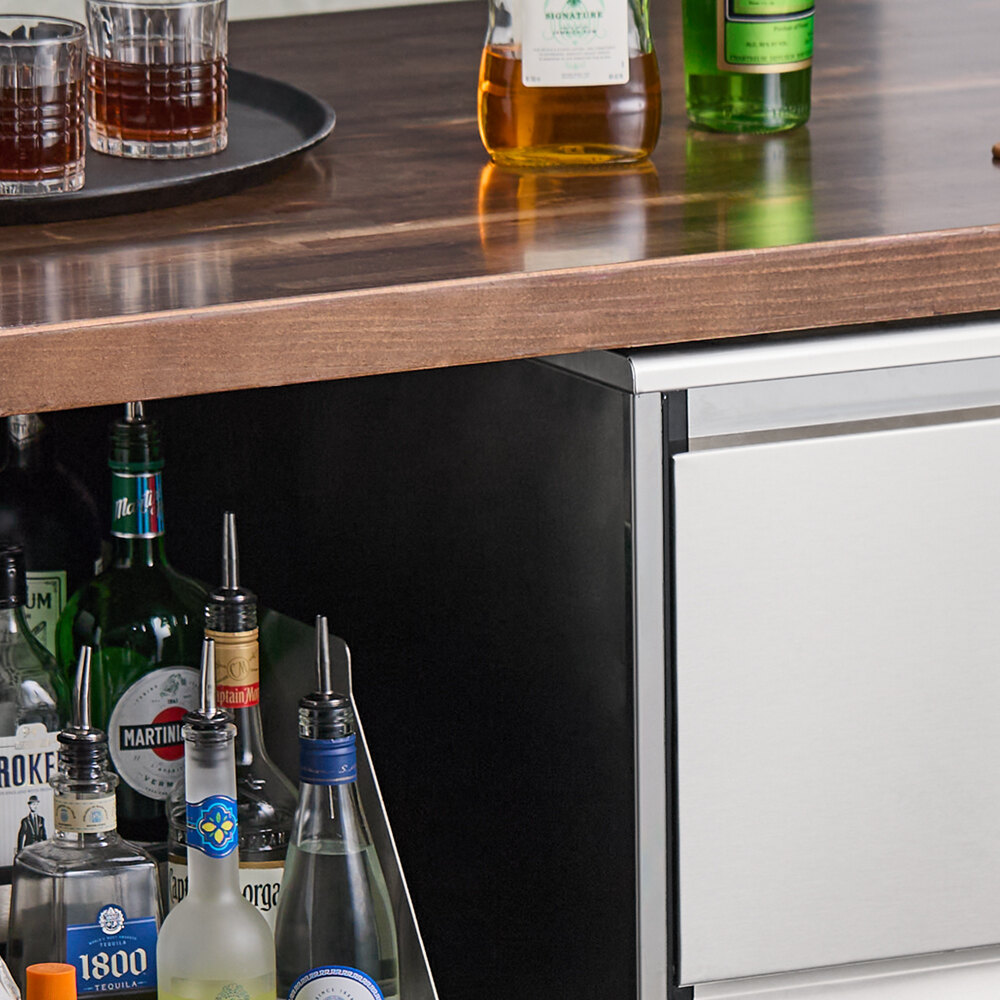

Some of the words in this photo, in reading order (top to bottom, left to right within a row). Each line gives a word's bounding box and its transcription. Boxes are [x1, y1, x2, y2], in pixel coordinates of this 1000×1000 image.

[545, 11, 603, 20] SIGNATURE
[123, 725, 181, 747] MARTINI
[79, 948, 148, 981] 1800
[94, 981, 138, 991] TEQUILA
